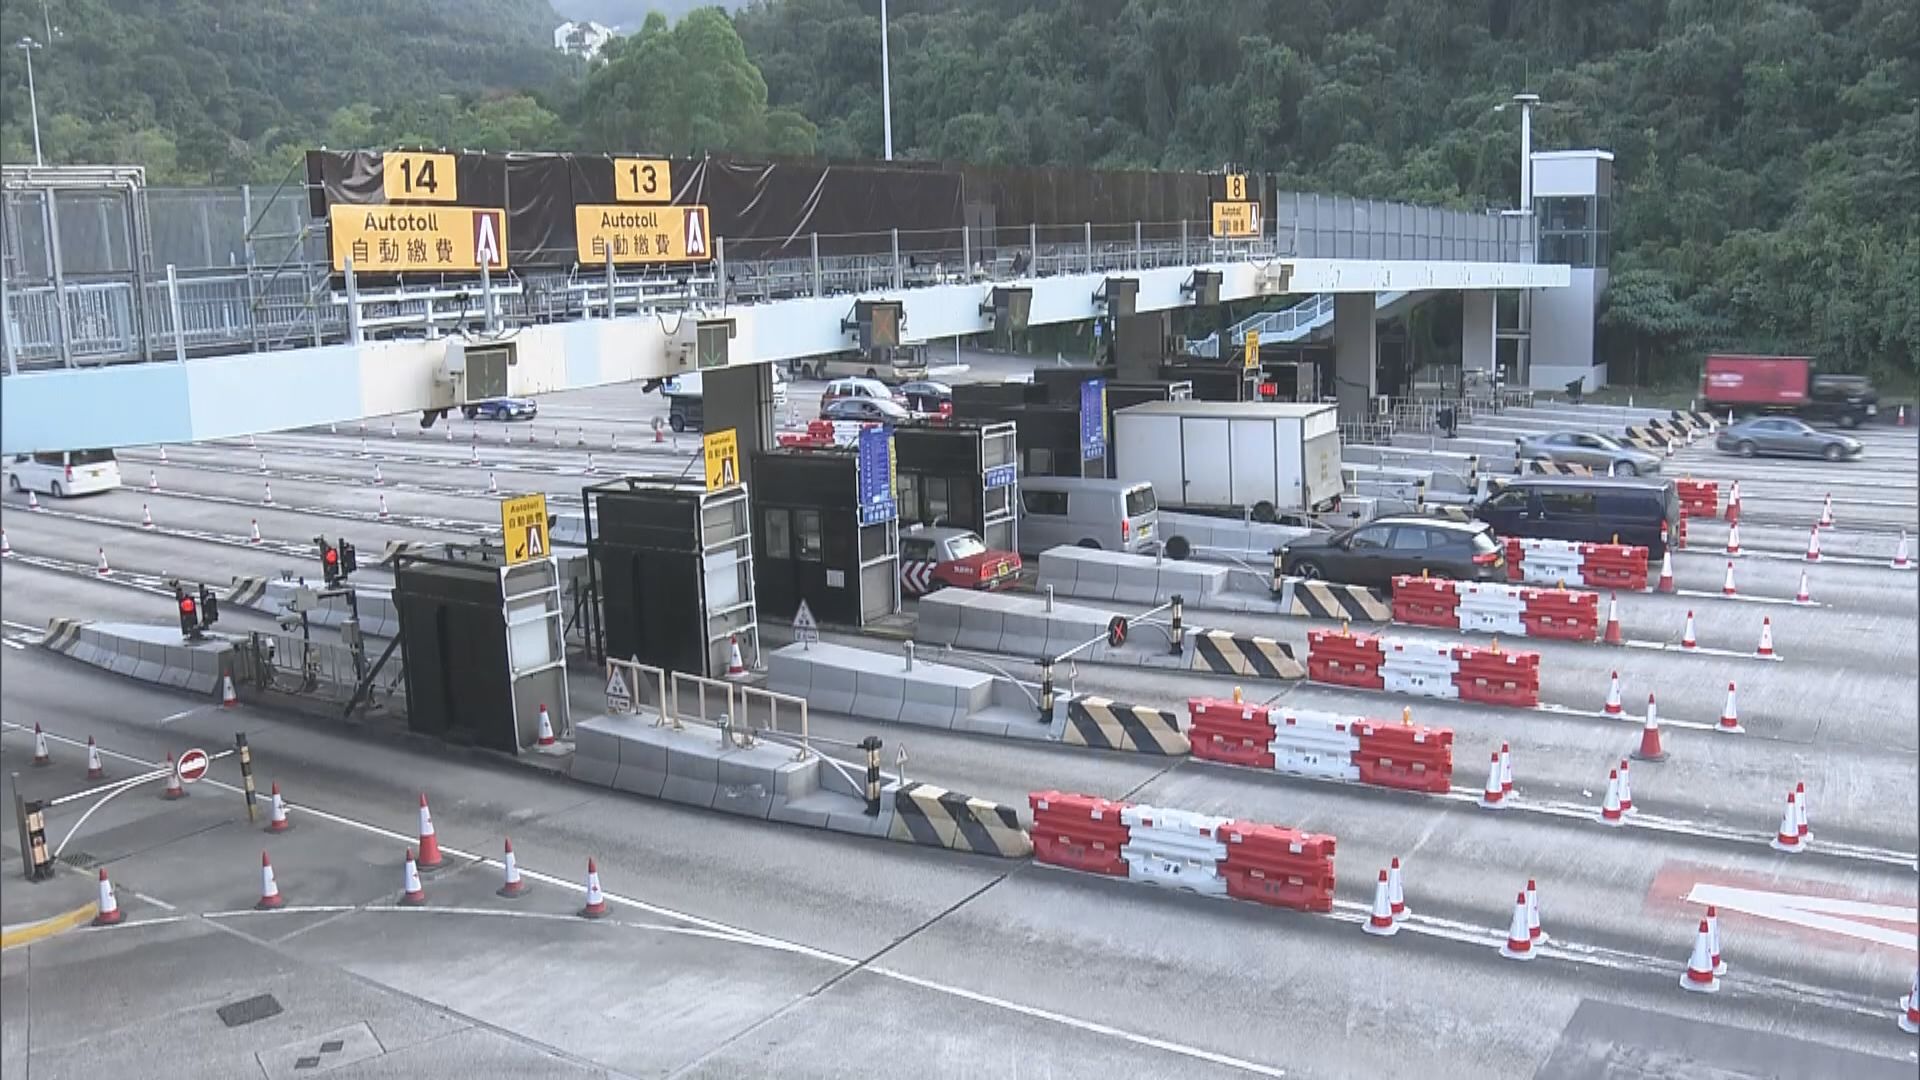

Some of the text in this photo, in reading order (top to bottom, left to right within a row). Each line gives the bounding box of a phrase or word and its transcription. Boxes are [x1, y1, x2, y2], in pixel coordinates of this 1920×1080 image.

[400, 158, 437, 194] 14
[629, 164, 657, 193] 13
[1233, 177, 1241, 198] 8
[364, 212, 439, 232] Autotoll
[600, 211, 658, 228] Autotoll
[352, 238, 453, 263] 自動繳費
